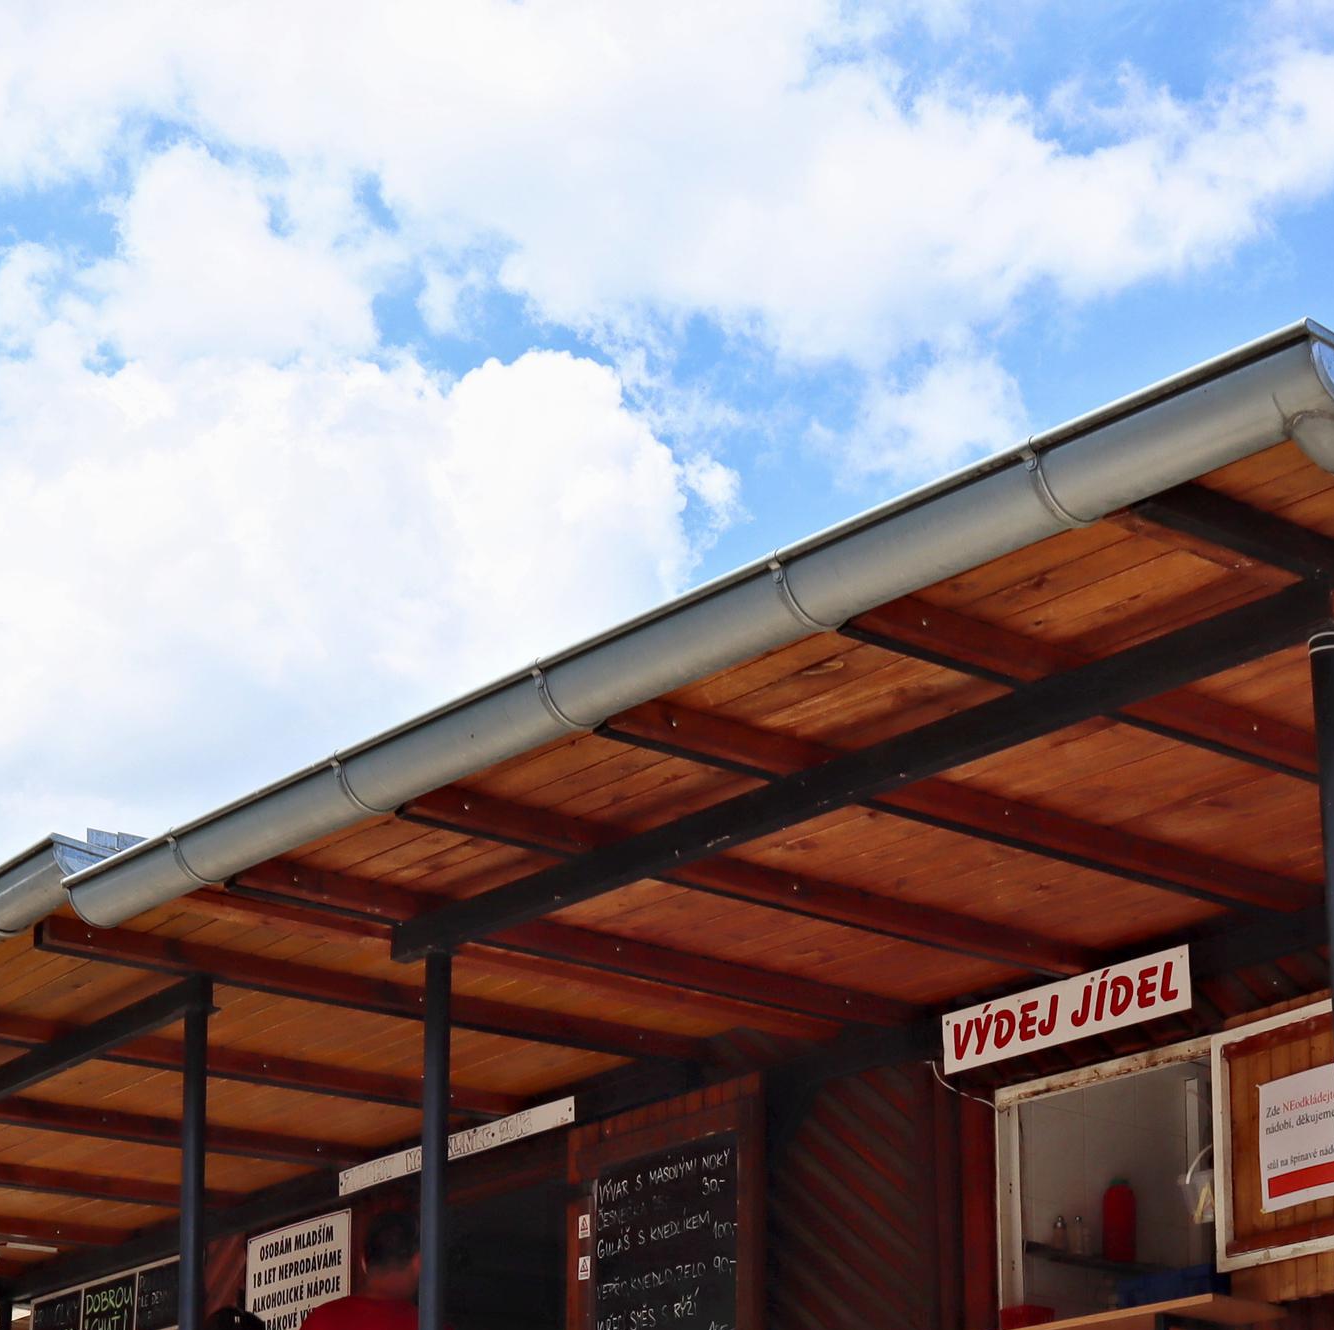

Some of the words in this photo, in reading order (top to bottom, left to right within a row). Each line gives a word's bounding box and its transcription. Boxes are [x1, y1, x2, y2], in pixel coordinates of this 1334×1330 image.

[952, 994, 1059, 1061] VÝDEJ
[1070, 961, 1179, 1028] JÍDEL
[1265, 1106, 1280, 1119] Zde
[598, 1178, 630, 1205] VÝVAR
[702, 1147, 731, 1172] NOKY
[259, 1235, 292, 1262] OSOBÁM
[294, 1223, 334, 1251] MLADŠÍM
[253, 1272, 262, 1288] 18
[264, 1267, 277, 1286] LET
[278, 1249, 342, 1281] NEPRODÁVÁME
[86, 1286, 133, 1314] DOBROU
[252, 1281, 304, 1314] ALKOHOLICKÉ
[306, 1276, 341, 1299] NÁPOJE
